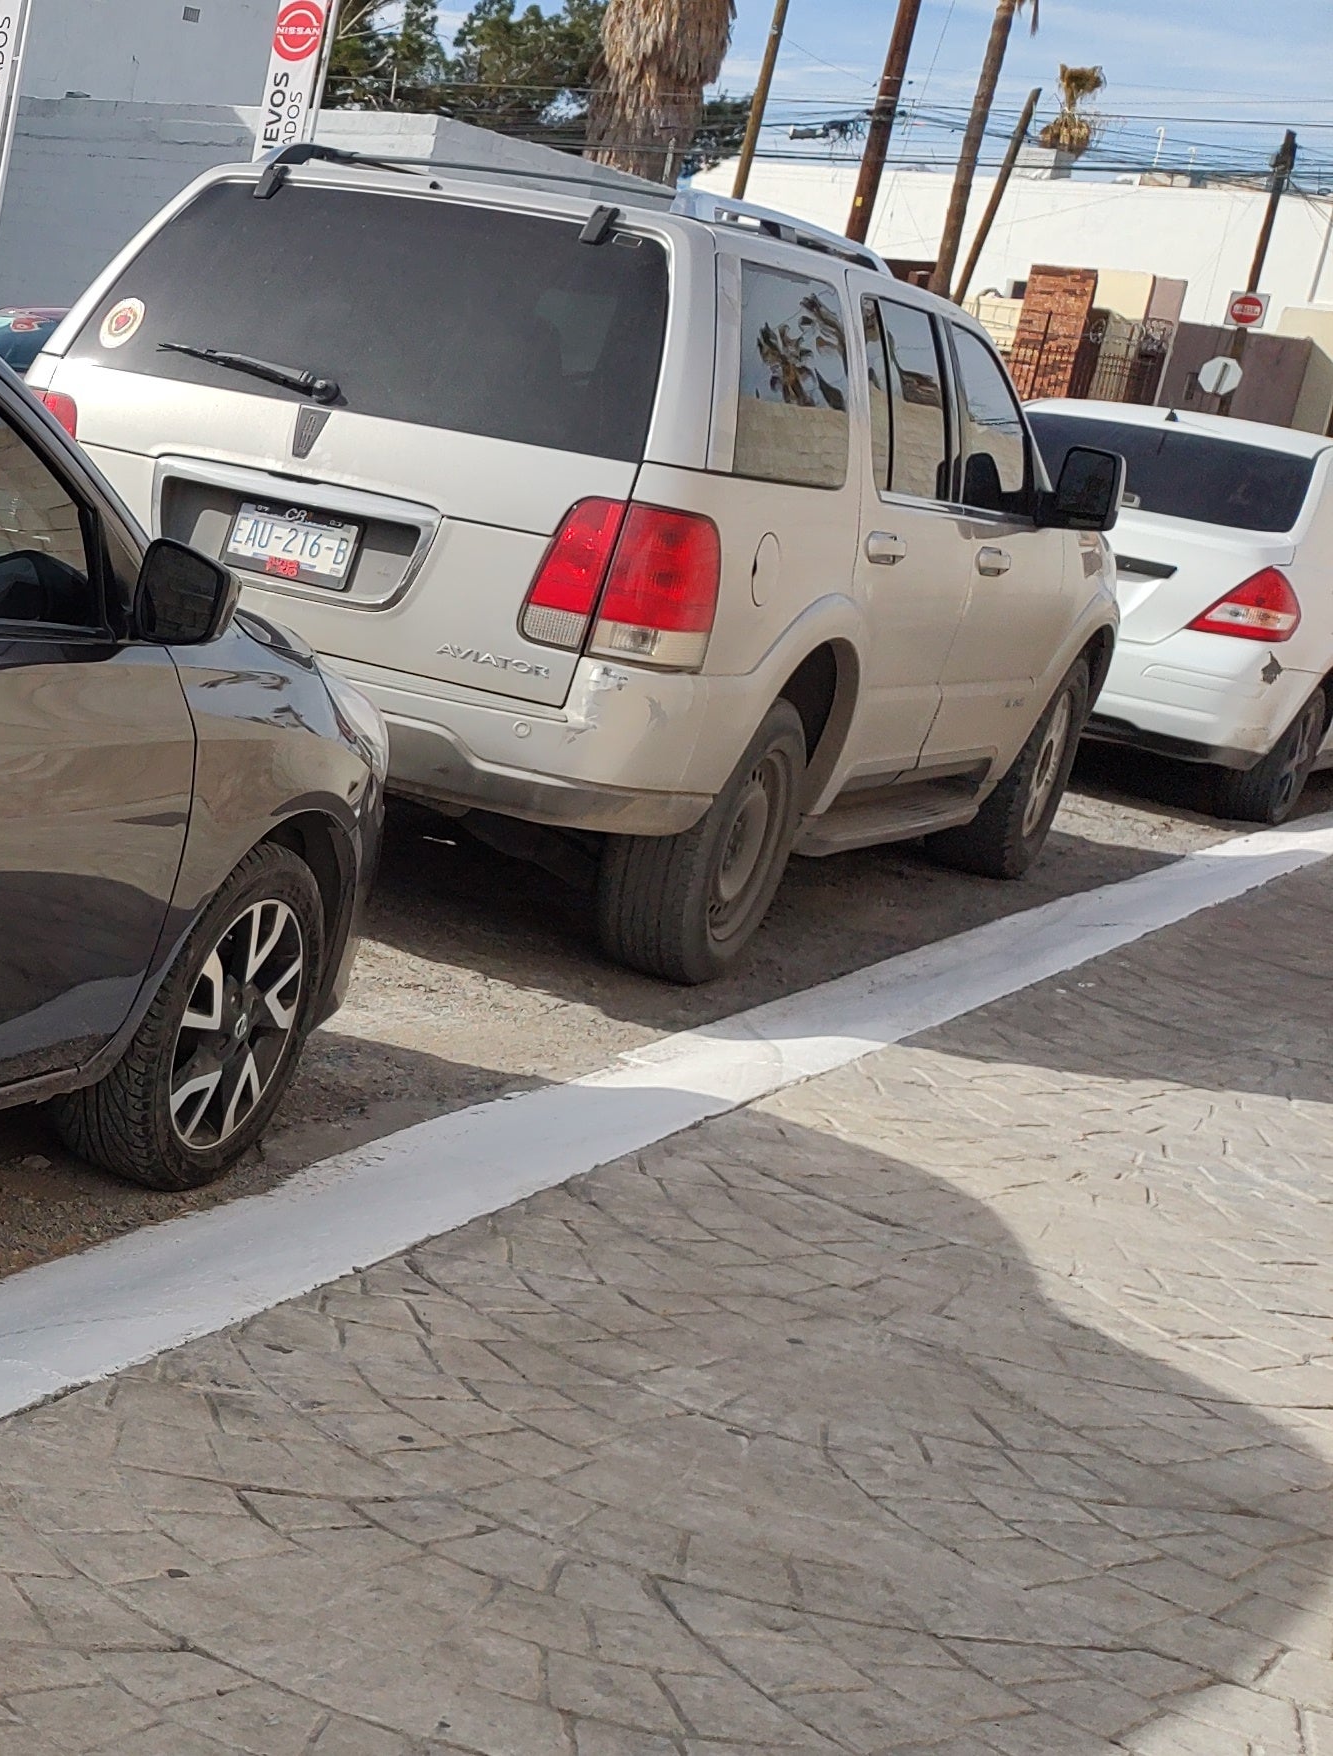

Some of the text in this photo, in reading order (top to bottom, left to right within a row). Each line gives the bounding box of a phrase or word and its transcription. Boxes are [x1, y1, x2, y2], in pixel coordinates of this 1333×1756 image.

[276, 26, 321, 36] NISSAN
[262, 71, 290, 149] EVOS
[233, 516, 349, 566] EAU-216-B
[436, 643, 550, 679] AVIATOR
